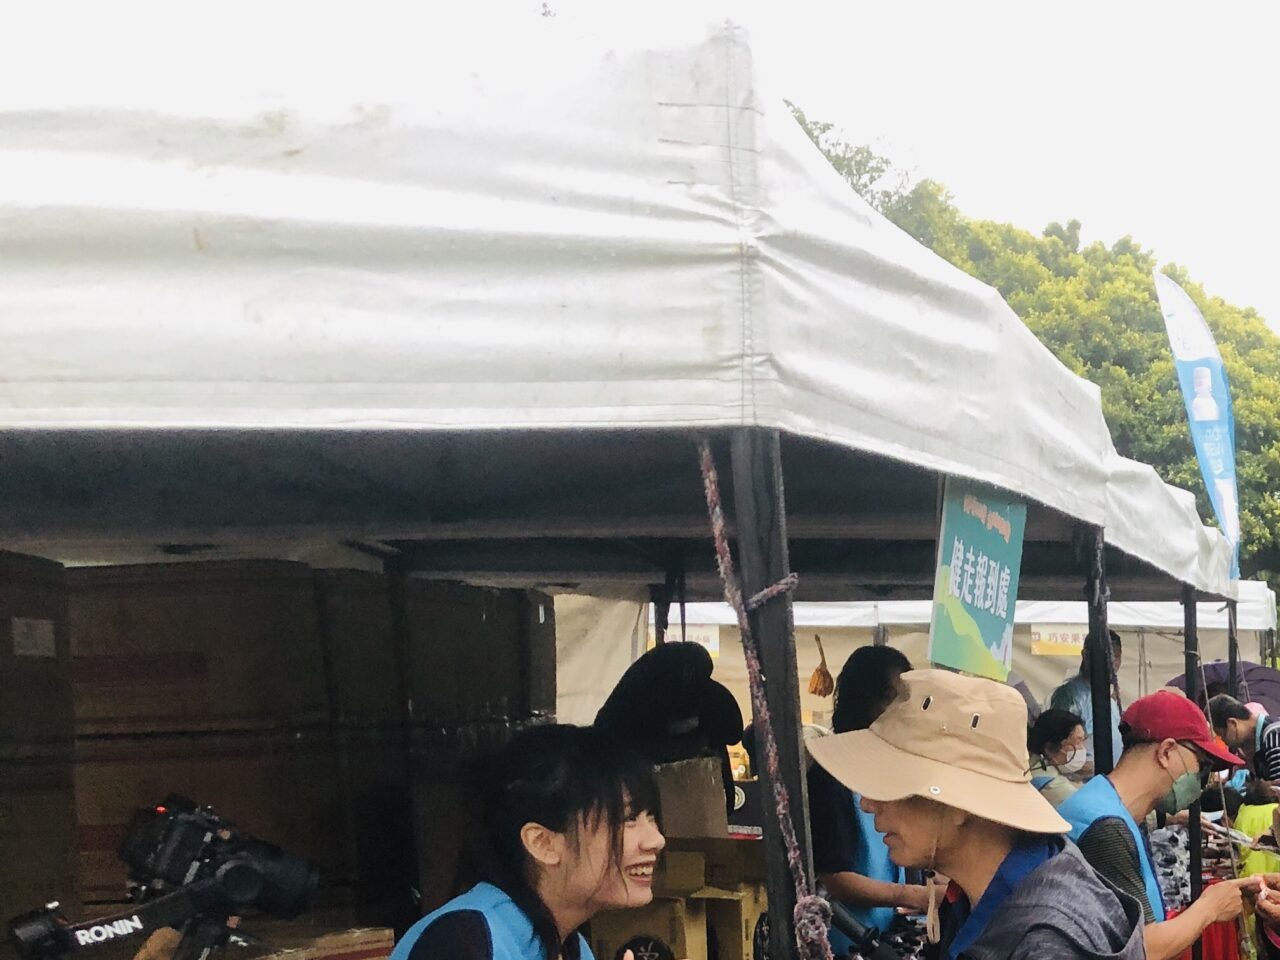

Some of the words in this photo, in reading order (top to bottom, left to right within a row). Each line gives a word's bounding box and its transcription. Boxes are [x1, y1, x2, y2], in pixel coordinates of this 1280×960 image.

[949, 535, 1011, 619] 健走報到處
[75, 915, 143, 945] RONIN
